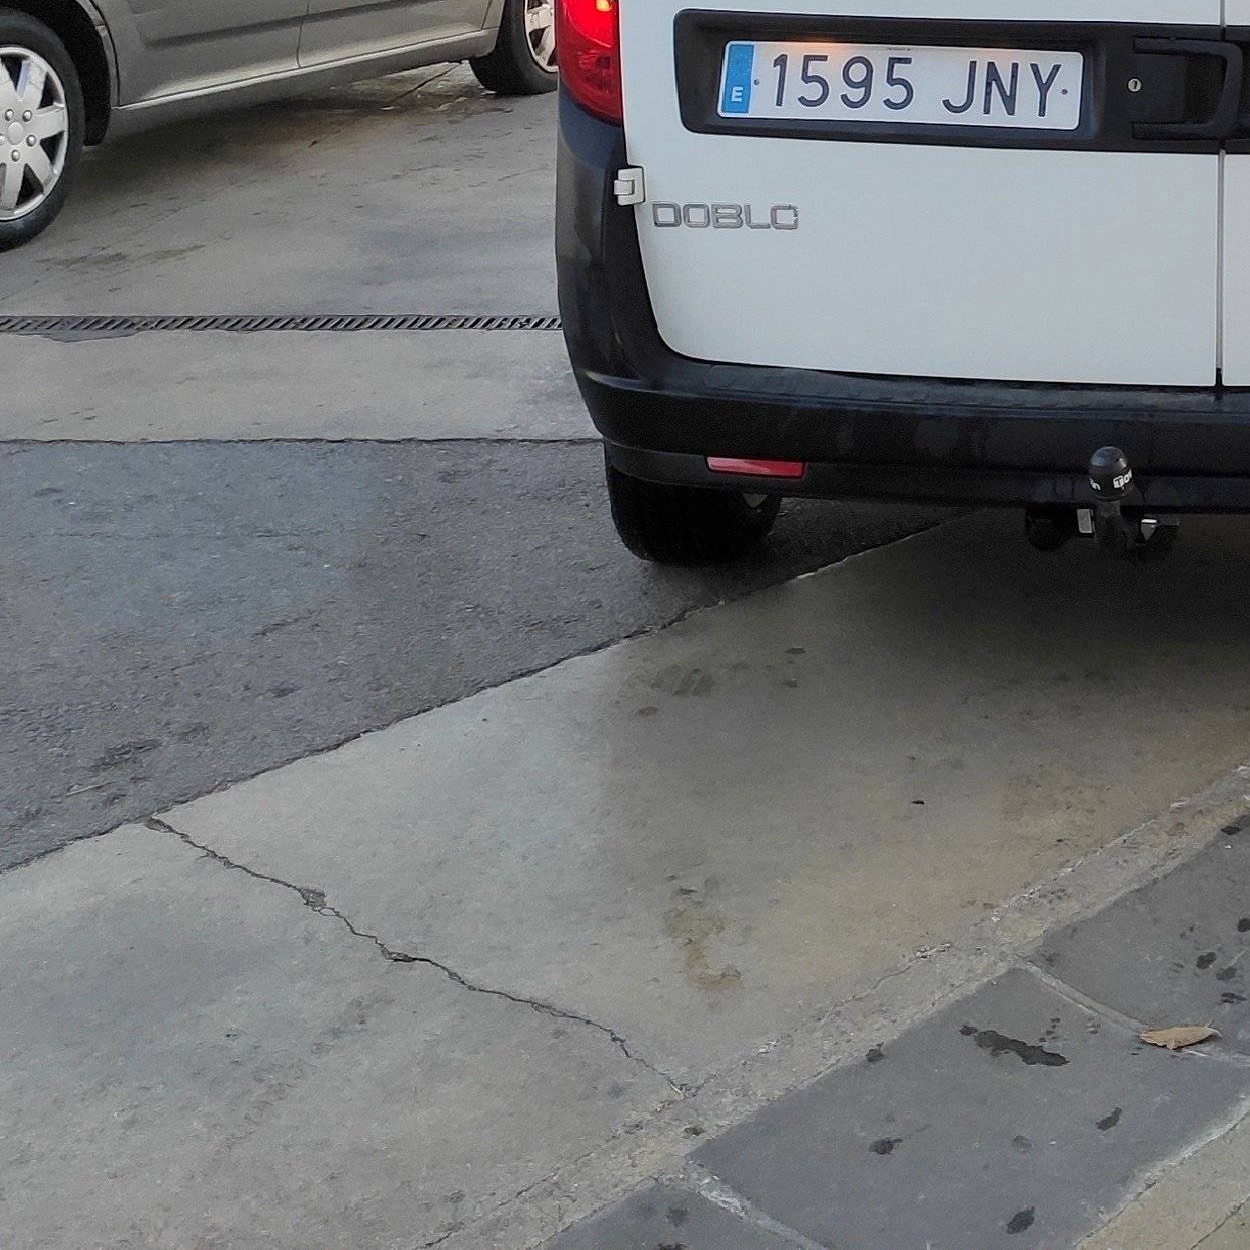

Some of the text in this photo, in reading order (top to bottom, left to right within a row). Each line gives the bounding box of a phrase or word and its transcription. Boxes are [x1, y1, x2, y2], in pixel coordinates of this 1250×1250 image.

[731, 86, 743, 103] E
[772, 53, 1063, 117] 1595 JNY
[651, 202, 800, 231] DOBLO
